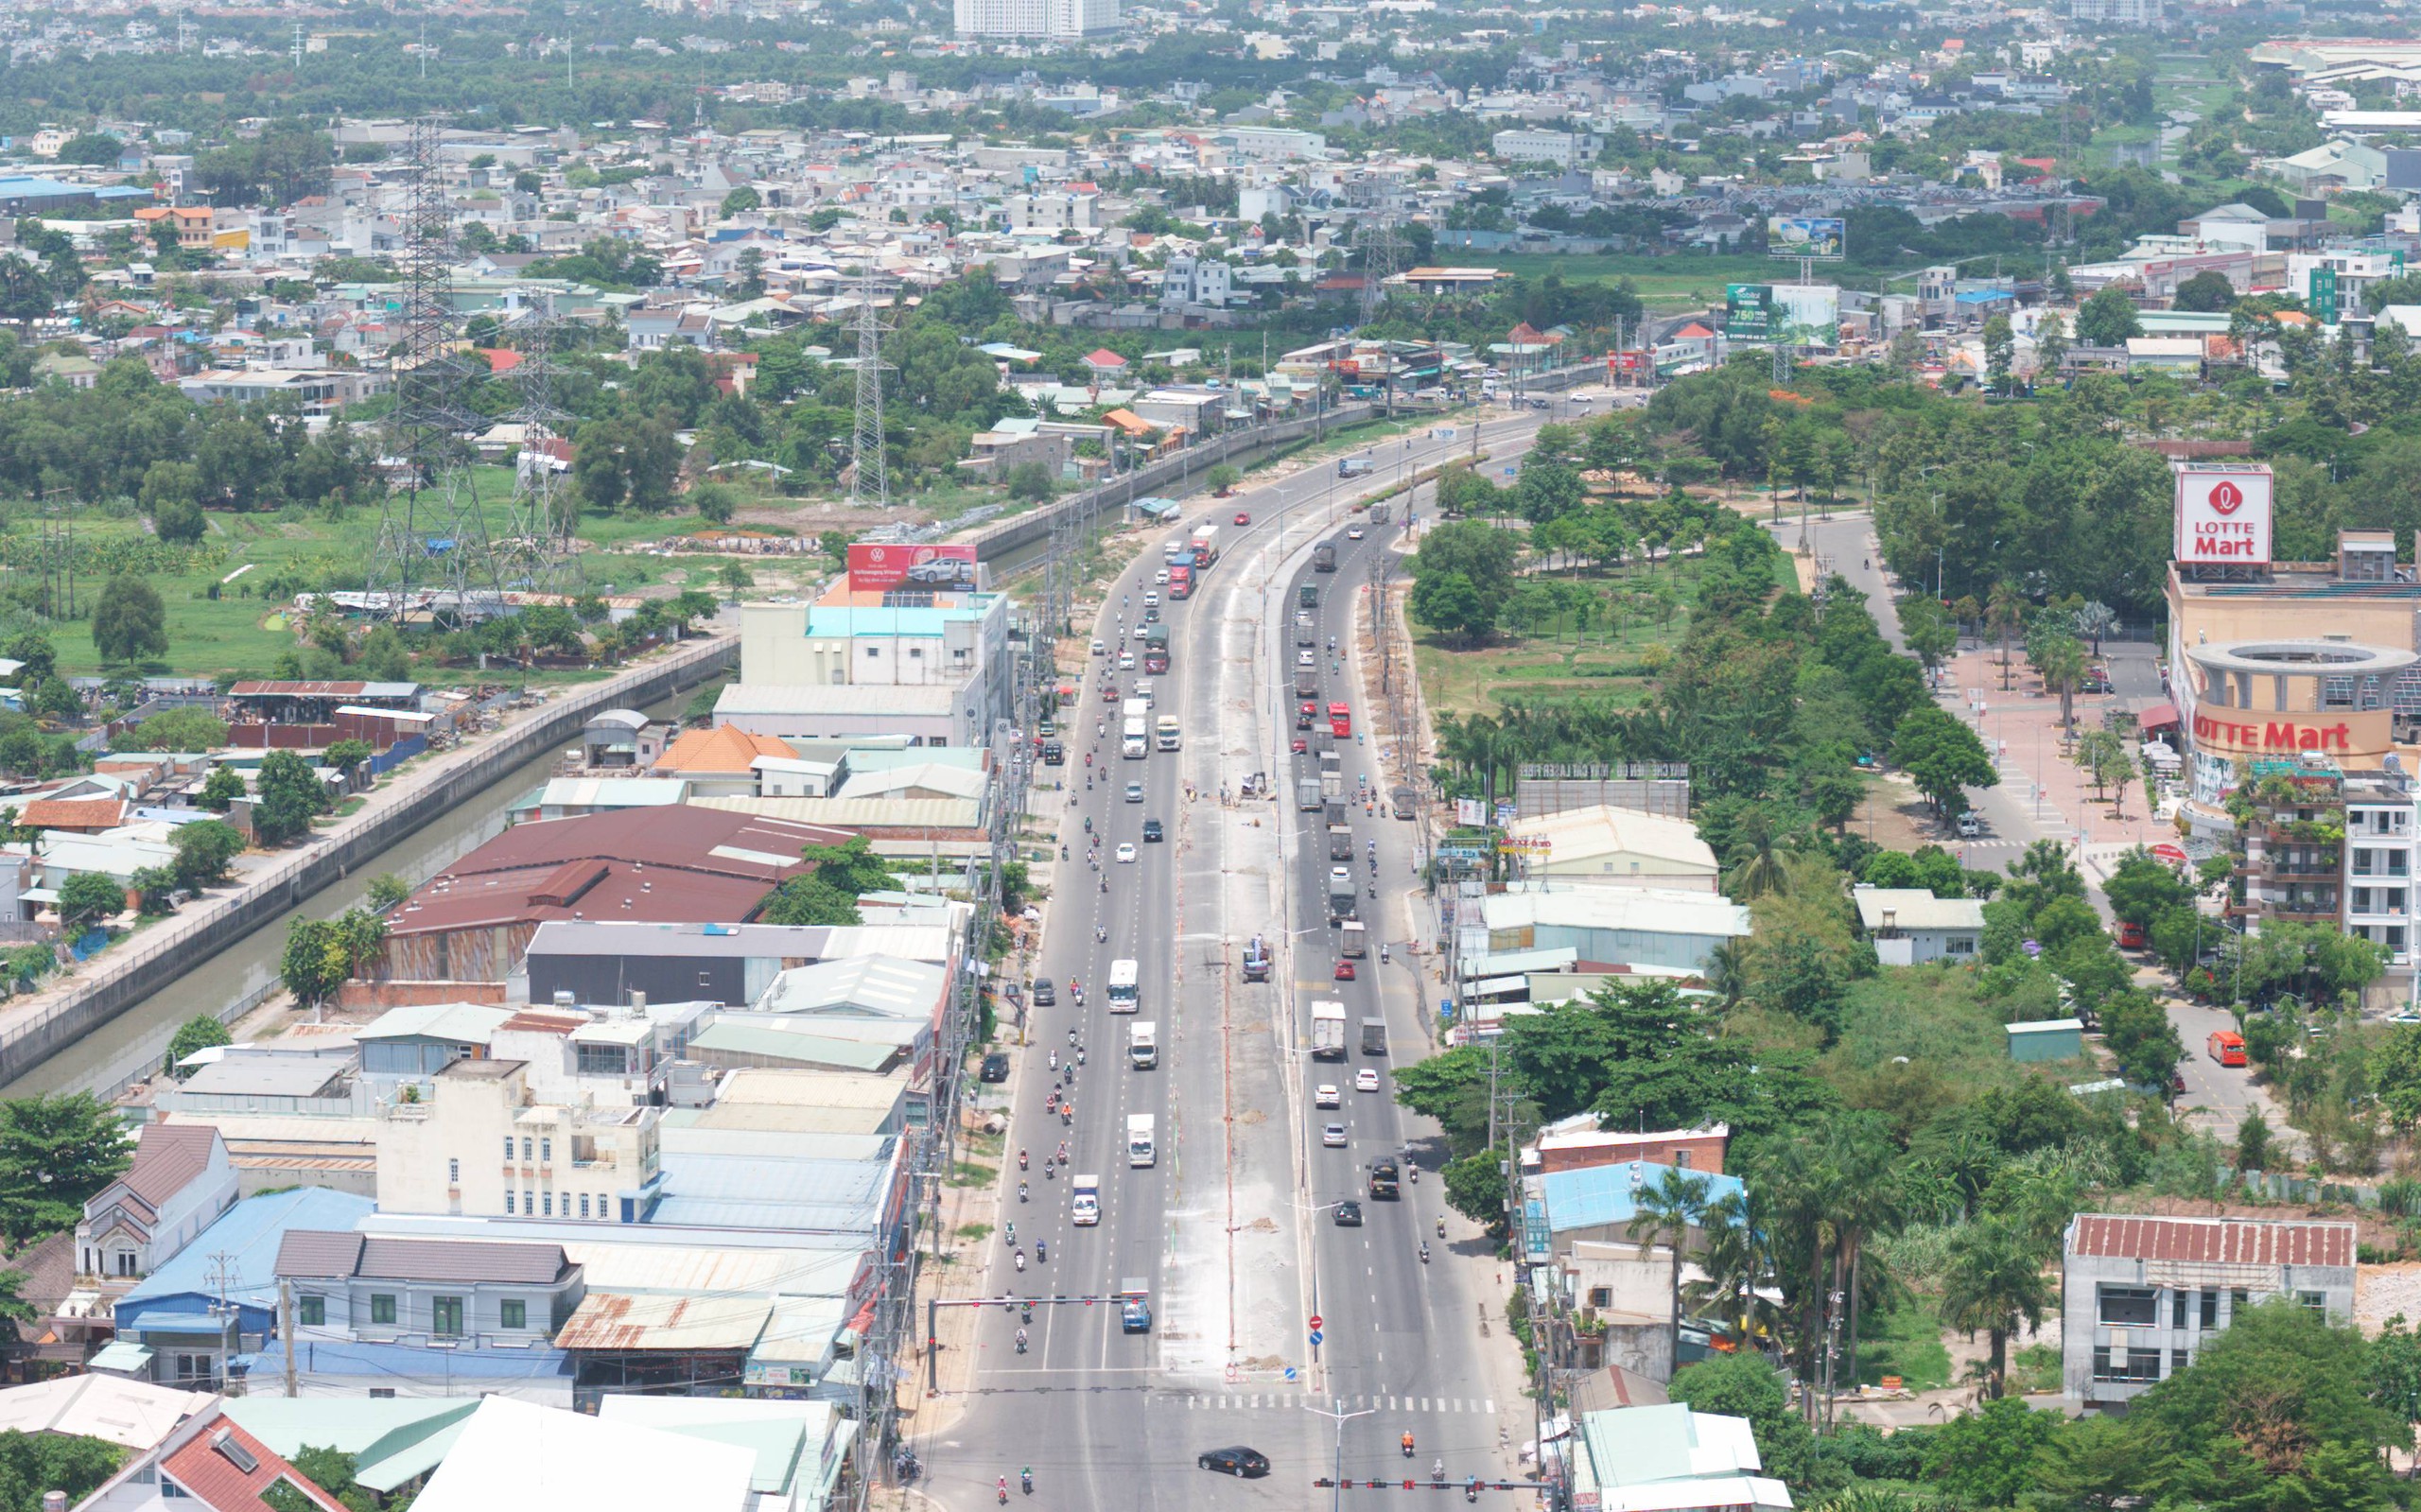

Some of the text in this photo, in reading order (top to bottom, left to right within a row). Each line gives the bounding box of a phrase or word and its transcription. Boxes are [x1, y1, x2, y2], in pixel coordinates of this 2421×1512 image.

[1733, 310, 1754, 321] 750
[2195, 522, 2255, 534] LOTTE
[2194, 537, 2255, 556] Mart
[2264, 721, 2350, 750] Mart
